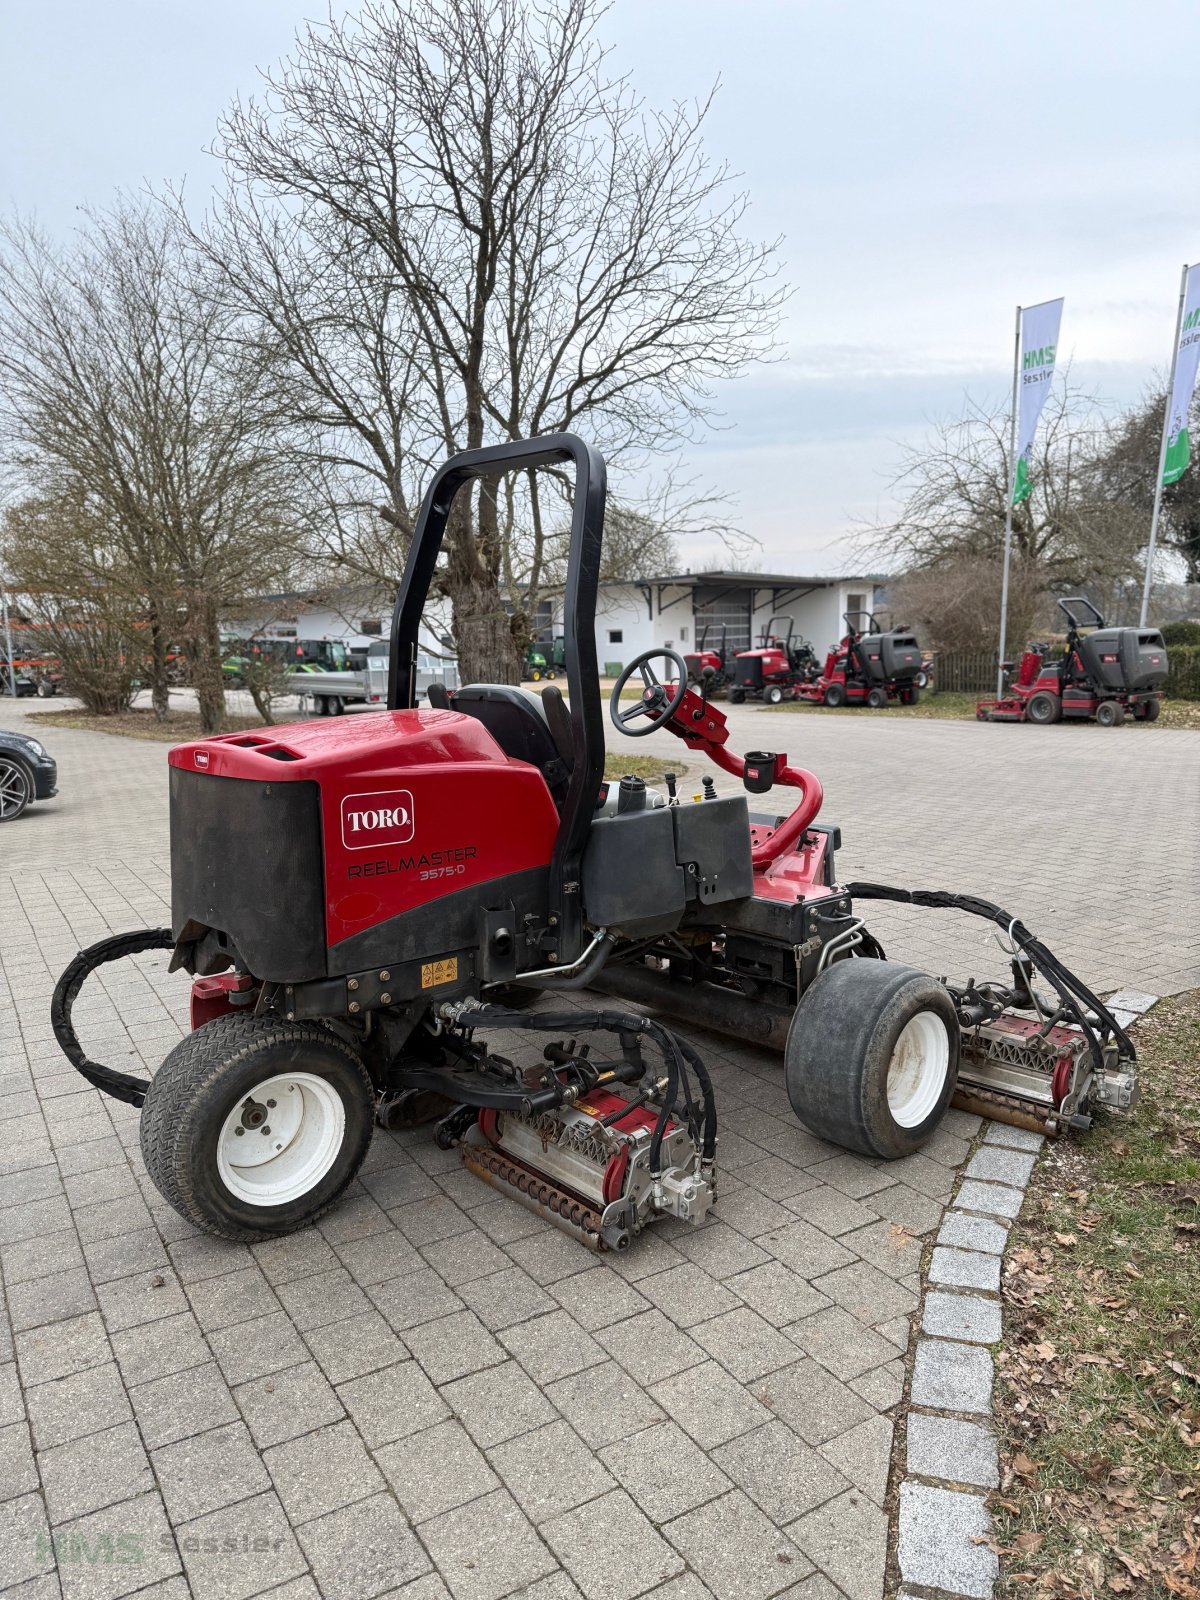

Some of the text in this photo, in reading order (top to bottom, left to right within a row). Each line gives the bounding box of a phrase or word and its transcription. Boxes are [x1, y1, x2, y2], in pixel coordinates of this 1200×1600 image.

[1180, 332, 1200, 349] essle
[1023, 345, 1055, 370] HMS
[347, 807, 408, 832] TORO
[347, 846, 477, 880] REELMASTER
